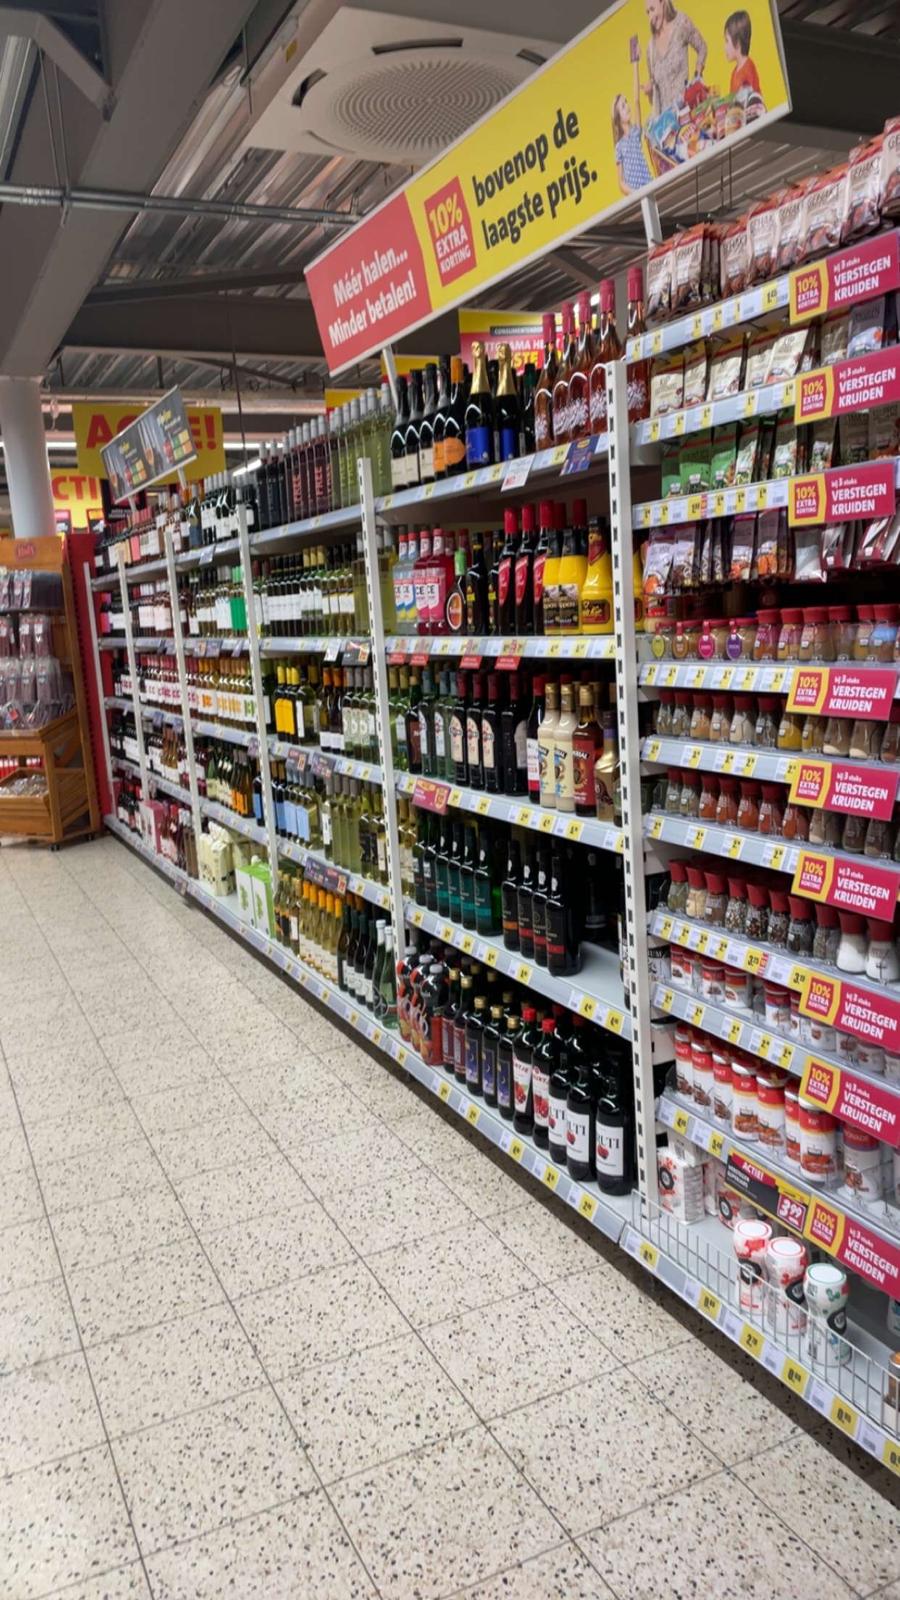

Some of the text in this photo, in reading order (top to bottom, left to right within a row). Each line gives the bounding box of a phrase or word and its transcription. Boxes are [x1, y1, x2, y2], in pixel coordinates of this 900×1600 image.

[472, 107, 580, 207] bovenop de
[481, 155, 598, 250] laagste prijs.
[429, 192, 463, 238] 10%
[435, 224, 469, 258] EXTRA
[440, 244, 472, 274] KORTING
[332, 248, 409, 307] Méér halen...
[834, 255, 891, 286] VERSTEGEN
[798, 275, 817, 292] 10%
[834, 275, 879, 302] KRUIDEN
[798, 288, 819, 300] EXTRA
[328, 270, 418, 348] Minder betalen!
[803, 380, 824, 395] 10%
[840, 368, 896, 393] VERSTEGEN
[803, 393, 824, 404] EXTRA
[839, 387, 883, 408] KRUIDEN
[796, 486, 816, 499] 10%
[832, 483, 886, 501] VERSTEGEN
[796, 498, 816, 508] EXTRA
[832, 499, 875, 515] KRUIDEN
[800, 677, 818, 688] 10%
[797, 688, 816, 696] EXTRA
[833, 685, 887, 699] VERSTEGEN
[829, 698, 872, 712] KRUIDEN
[802, 769, 821, 782] 10%
[800, 780, 819, 790] EXTRA
[835, 782, 888, 800] VERSTEGEN
[831, 794, 874, 811] KRUIDEN
[802, 872, 822, 883] EXTRA
[805, 862, 823, 876] 10%
[837, 877, 890, 900] VERSTEGEN
[834, 889, 876, 910] KRUIDEN
[813, 982, 830, 998] 10%
[810, 993, 828, 1006] EXTRA
[845, 1001, 897, 1031] VERSTEGEN
[841, 1014, 883, 1039] KRUIDEN
[810, 1078, 828, 1093] EXTRA
[812, 1068, 830, 1085] 10%
[844, 1090, 896, 1125] VERSTEGEN
[840, 1103, 882, 1132] KRUIDEN
[816, 1208, 834, 1229] 10%
[814, 1219, 833, 1237] EXTRA
[844, 1248, 885, 1284] KRUIDEN
[848, 1236, 898, 1278] VERSTEGEN
